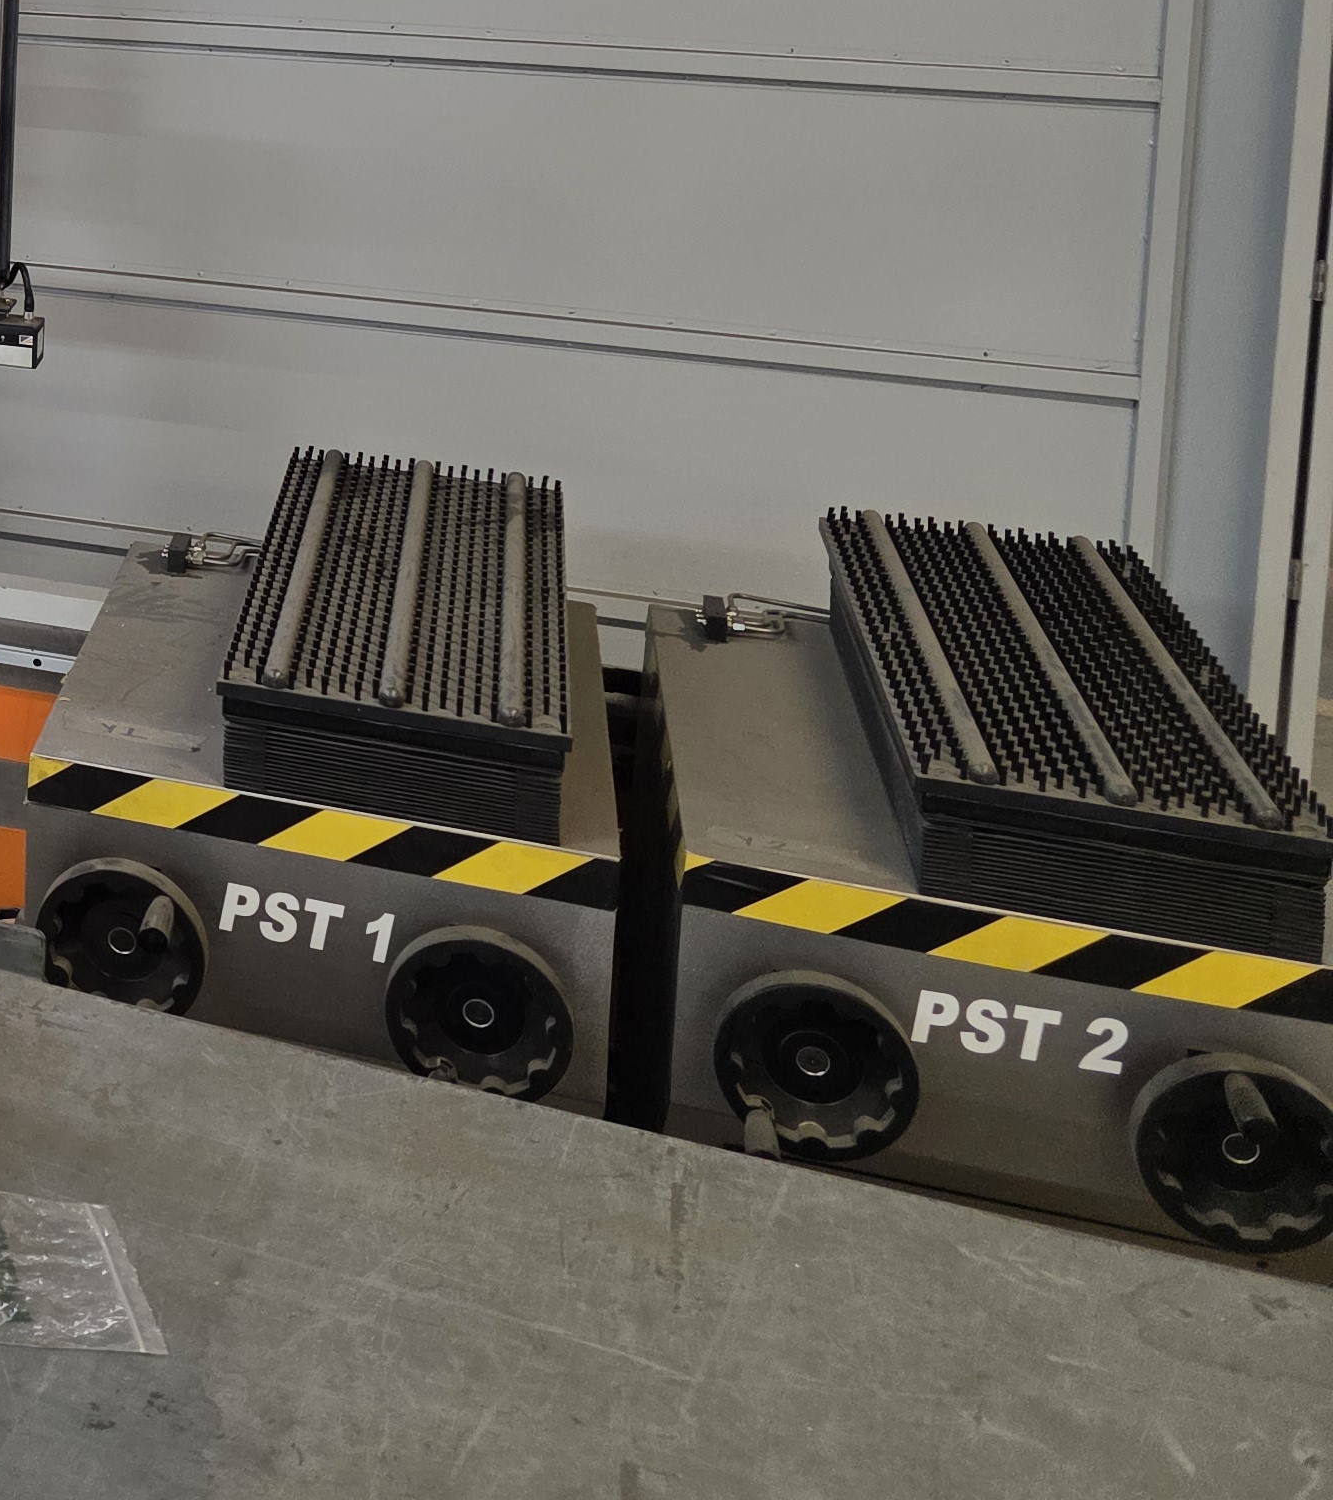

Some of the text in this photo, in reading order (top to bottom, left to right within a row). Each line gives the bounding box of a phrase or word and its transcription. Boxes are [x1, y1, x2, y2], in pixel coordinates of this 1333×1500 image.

[219, 881, 396, 964] PST 1
[910, 989, 1129, 1076] PST 2
